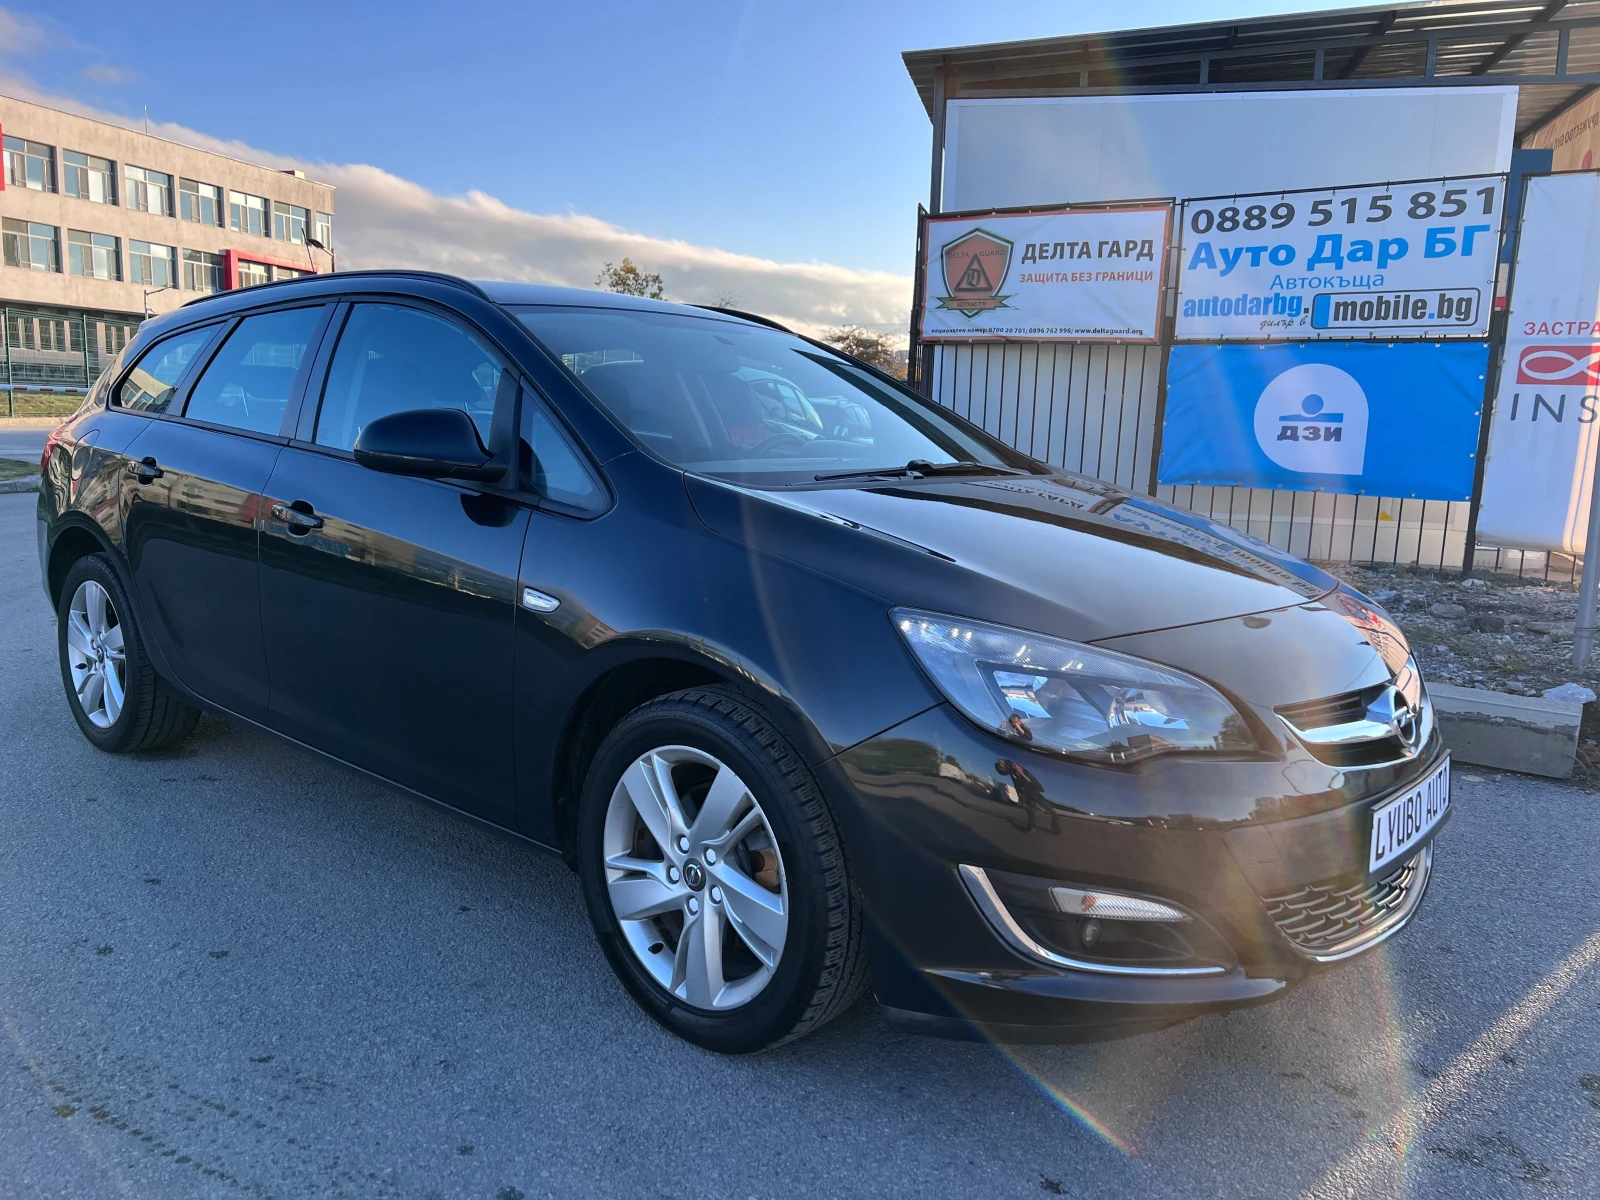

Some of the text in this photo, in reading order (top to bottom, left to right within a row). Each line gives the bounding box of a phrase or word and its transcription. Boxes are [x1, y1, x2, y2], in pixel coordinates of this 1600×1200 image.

[1191, 186, 1495, 234] 0889 515 851
[947, 249, 1006, 259] DELTA GUARD
[1021, 239, 1154, 264] ДЕЛТА ГАРД
[1187, 224, 1491, 277] Ауто Дар БГ
[1019, 271, 1154, 284] ЗАЩИТА БЕЗ ГРАНИЦИ
[1269, 272, 1385, 291] Автокъща
[1333, 293, 1473, 322] mobile.bg
[1074, 327, 1144, 336] www.deltaguard.org
[1276, 425, 1343, 442] ДЗИ
[1375, 765, 1447, 862] LYUBO AUTO
